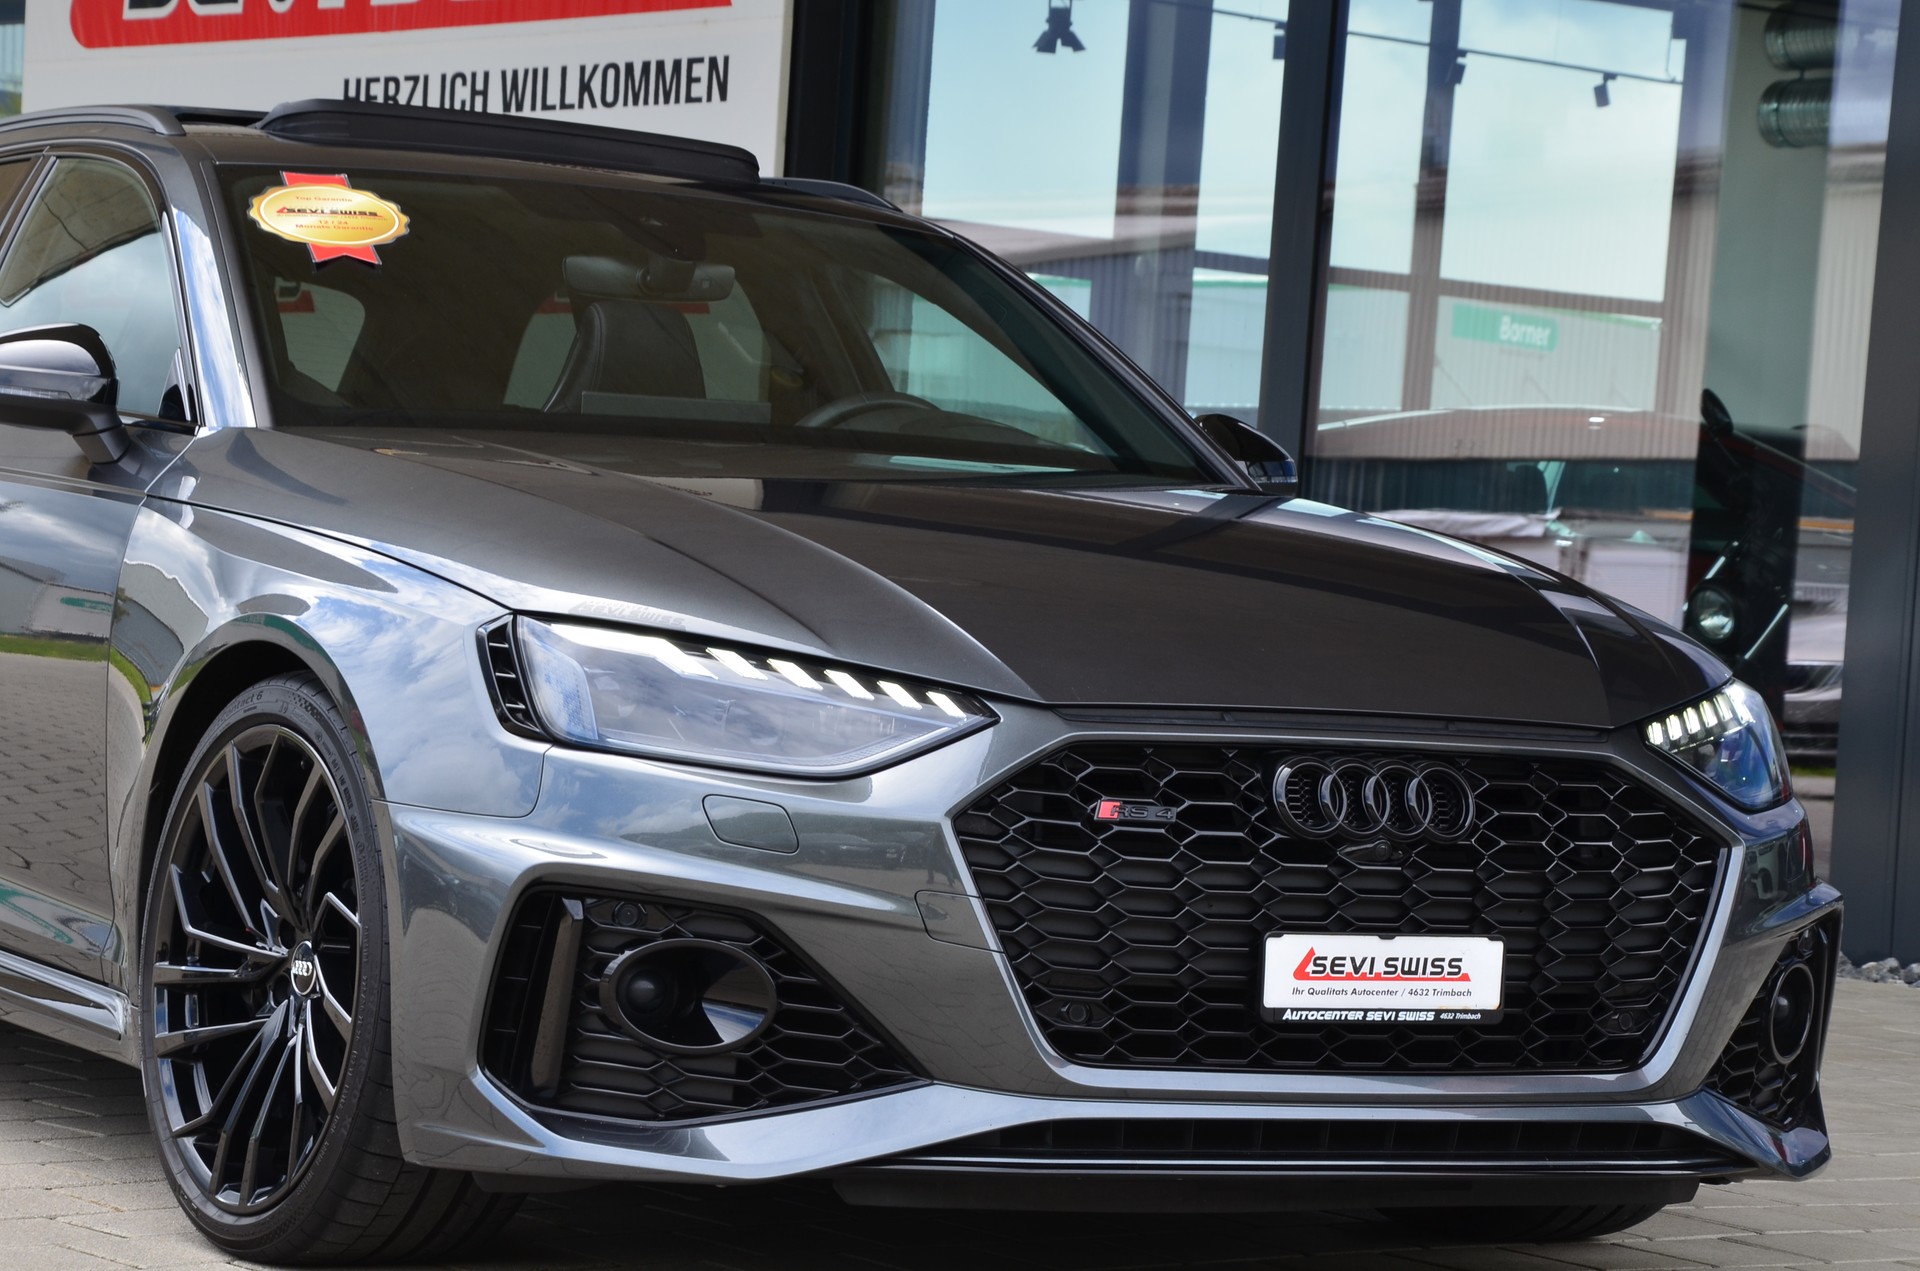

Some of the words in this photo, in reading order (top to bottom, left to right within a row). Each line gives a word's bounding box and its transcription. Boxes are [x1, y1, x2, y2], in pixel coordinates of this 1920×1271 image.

[343, 71, 490, 113] HERZLICH
[501, 54, 730, 113] WILLKOMMEN
[1110, 804, 1149, 818] RS
[1156, 807, 1174, 819] 4
[1311, 956, 1376, 976] SEVI
[1383, 957, 1463, 977] SWISS
[1292, 987, 1305, 995] Ihr
[1307, 987, 1348, 996] Qualitats
[1350, 988, 1398, 996] Autocenter
[1408, 988, 1430, 996] 4632
[1432, 988, 1472, 997] Trimbach
[1365, 1011, 1396, 1021] SEVI
[1397, 1011, 1436, 1021] SWISS
[1439, 1012, 1455, 1020] 4632
[1455, 1012, 1481, 1020] Trimbach
